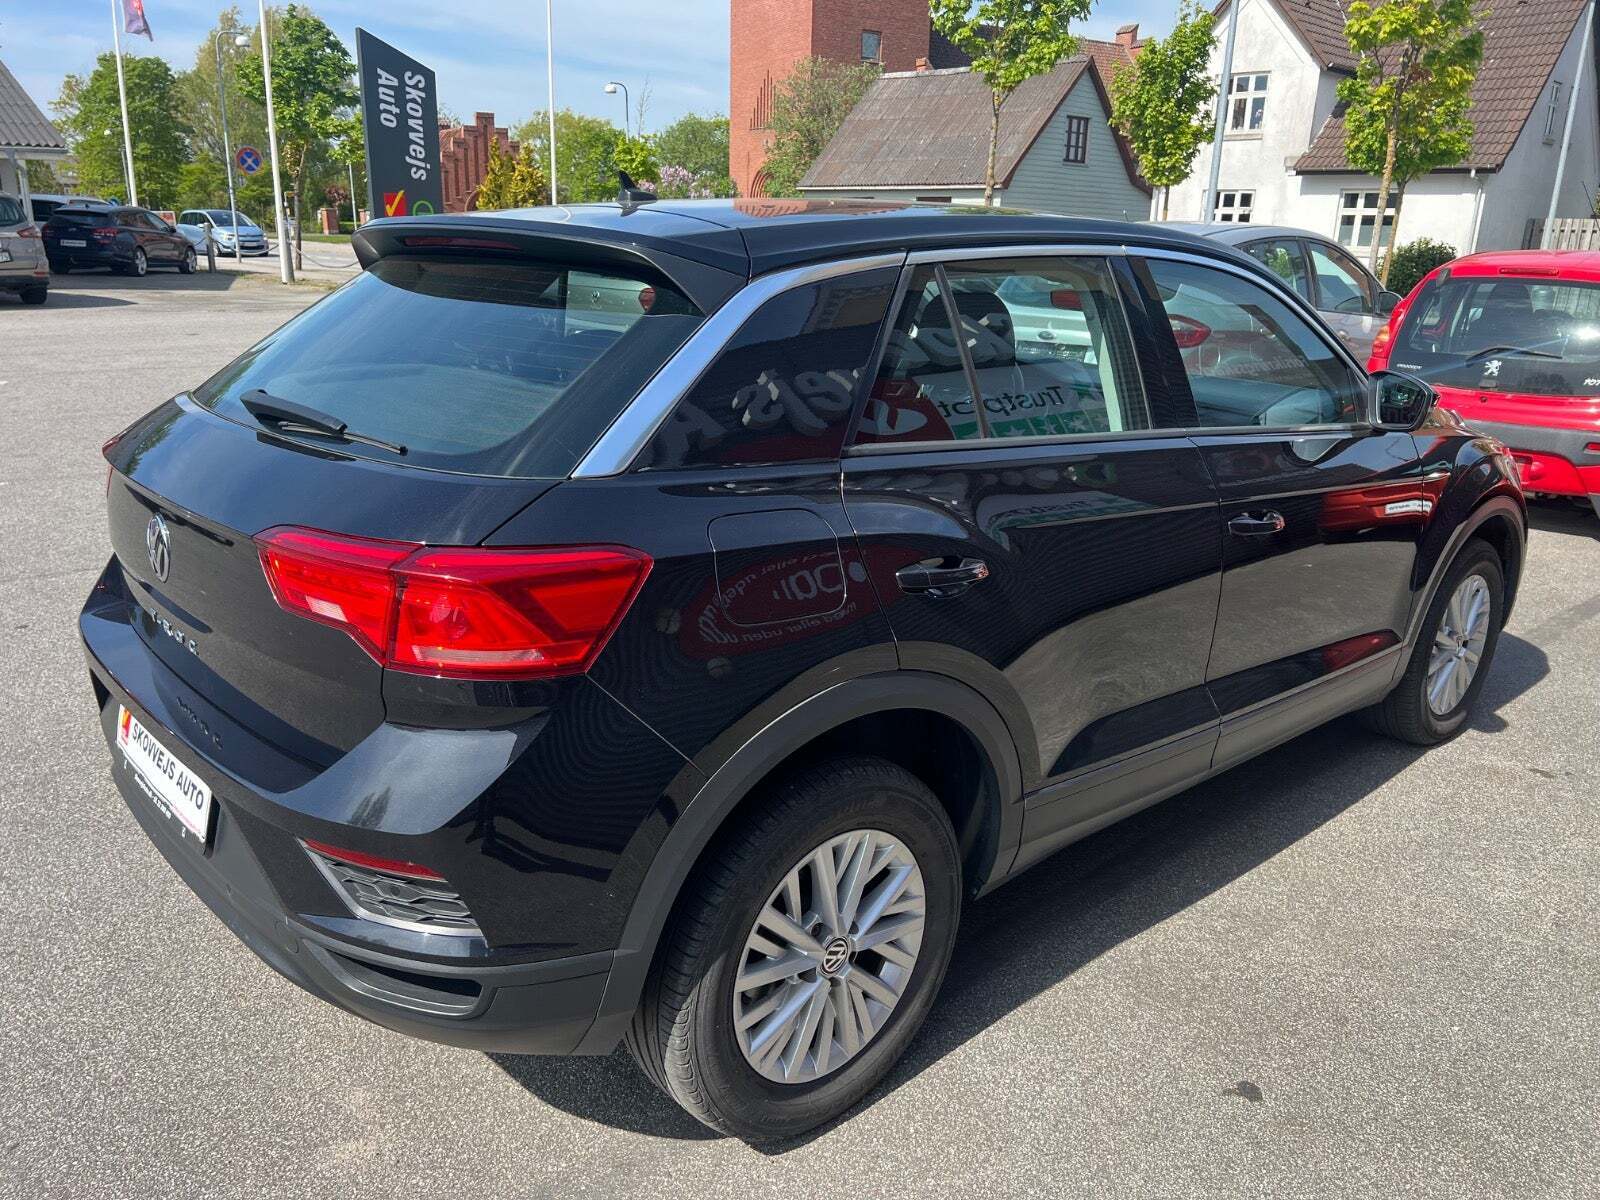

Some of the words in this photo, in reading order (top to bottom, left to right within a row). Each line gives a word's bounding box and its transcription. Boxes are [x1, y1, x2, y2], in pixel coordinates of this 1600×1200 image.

[376, 67, 400, 128] Auto
[404, 71, 430, 181] Skovvejs
[132, 723, 177, 780] SKOVVEJS
[176, 770, 205, 810] AUTO
